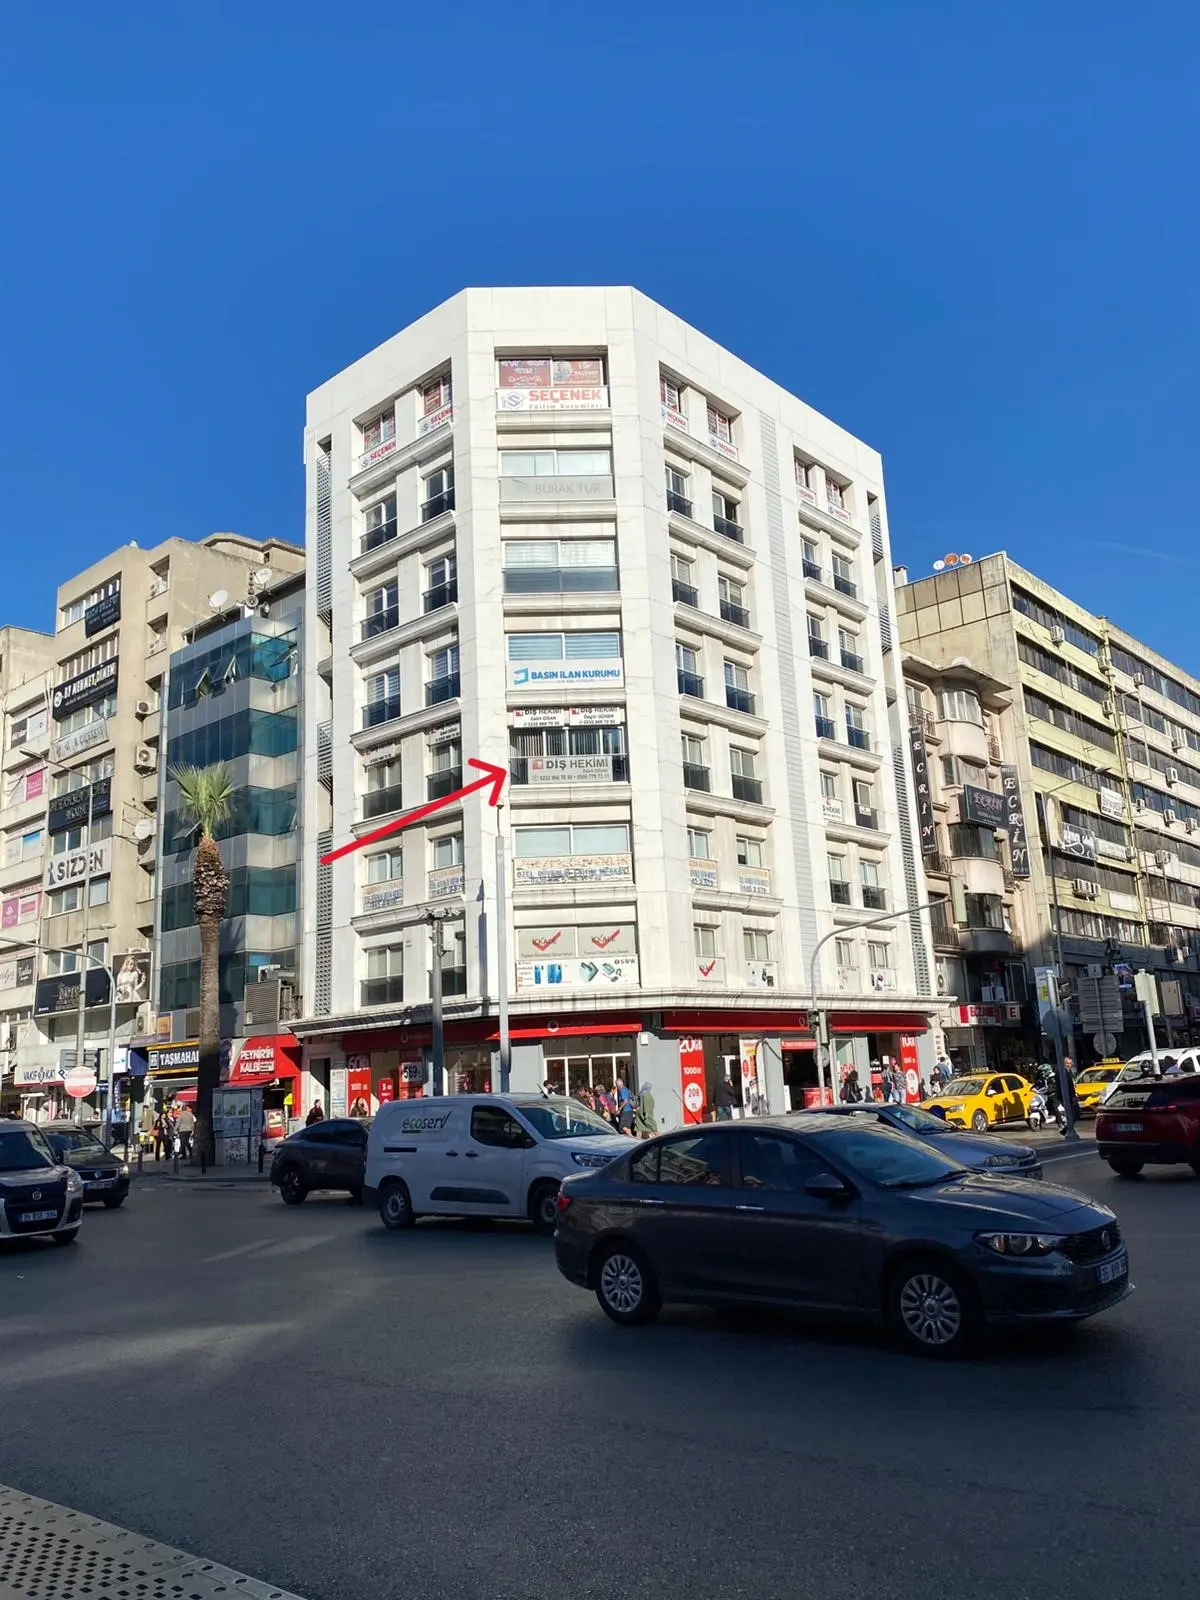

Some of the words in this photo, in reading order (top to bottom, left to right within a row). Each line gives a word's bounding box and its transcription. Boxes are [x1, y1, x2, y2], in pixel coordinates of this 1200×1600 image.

[529, 389, 601, 403] SEÇENEK
[535, 483, 574, 494] BURAK
[578, 482, 601, 493] TUR
[531, 671, 558, 680] BASIN
[559, 669, 581, 679] İLAN
[582, 669, 620, 678] KURUMU
[546, 759, 567, 770] DİŞ
[570, 758, 608, 769] HEKİMİ
